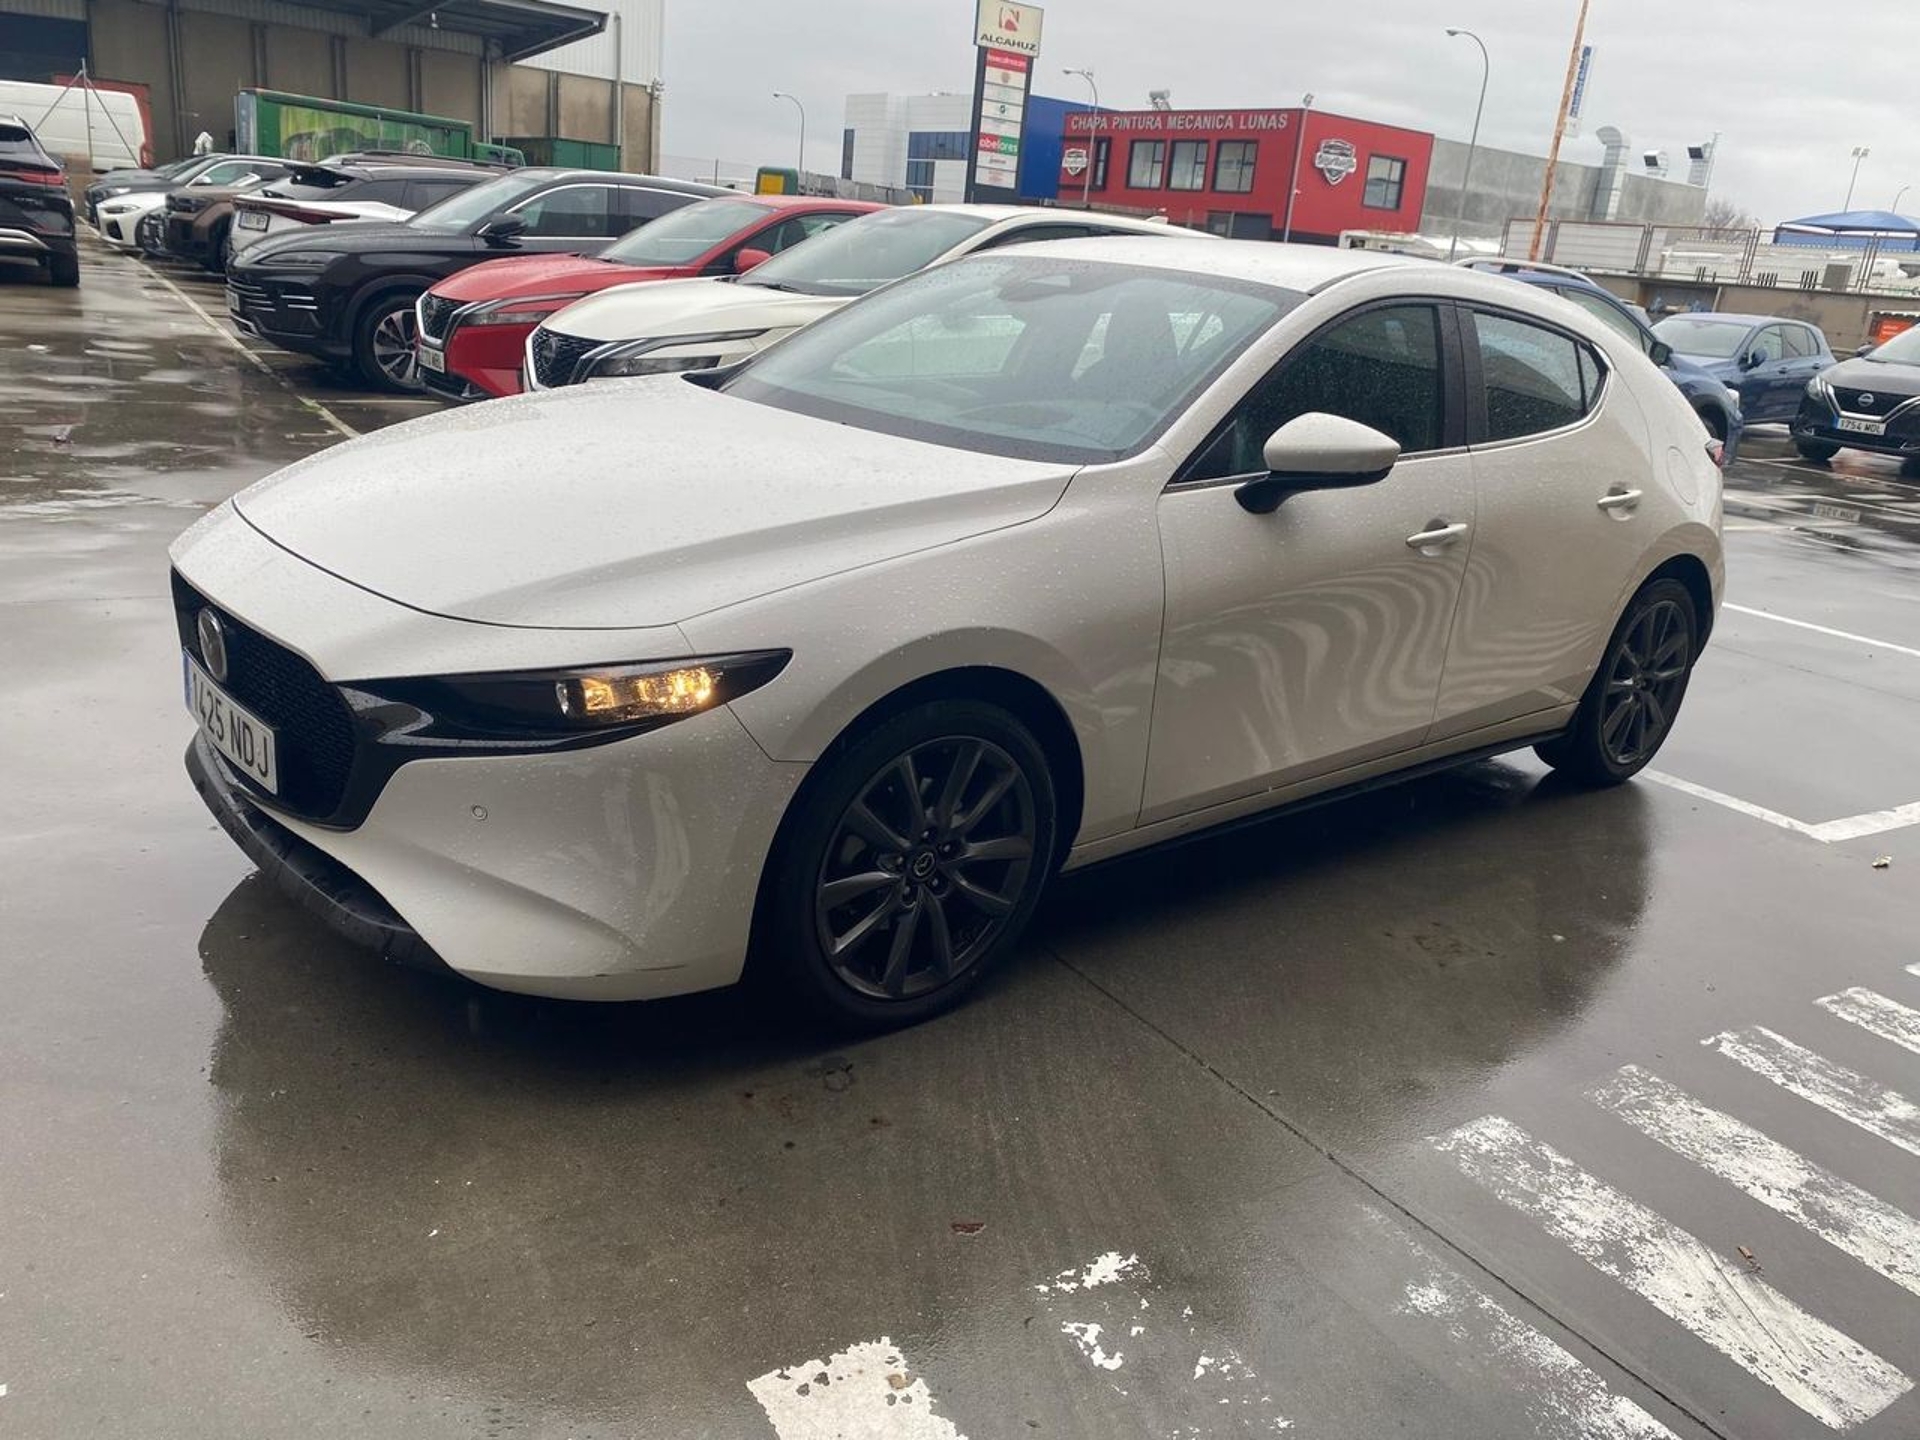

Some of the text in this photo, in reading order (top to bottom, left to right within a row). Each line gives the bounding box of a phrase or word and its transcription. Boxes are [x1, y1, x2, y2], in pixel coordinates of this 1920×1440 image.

[980, 33, 1037, 51] ALCAHUZ
[1071, 113, 1288, 130] CHAPA PINTURA MECANICA LUNAS
[192, 673, 269, 778] 1425 NDJ
